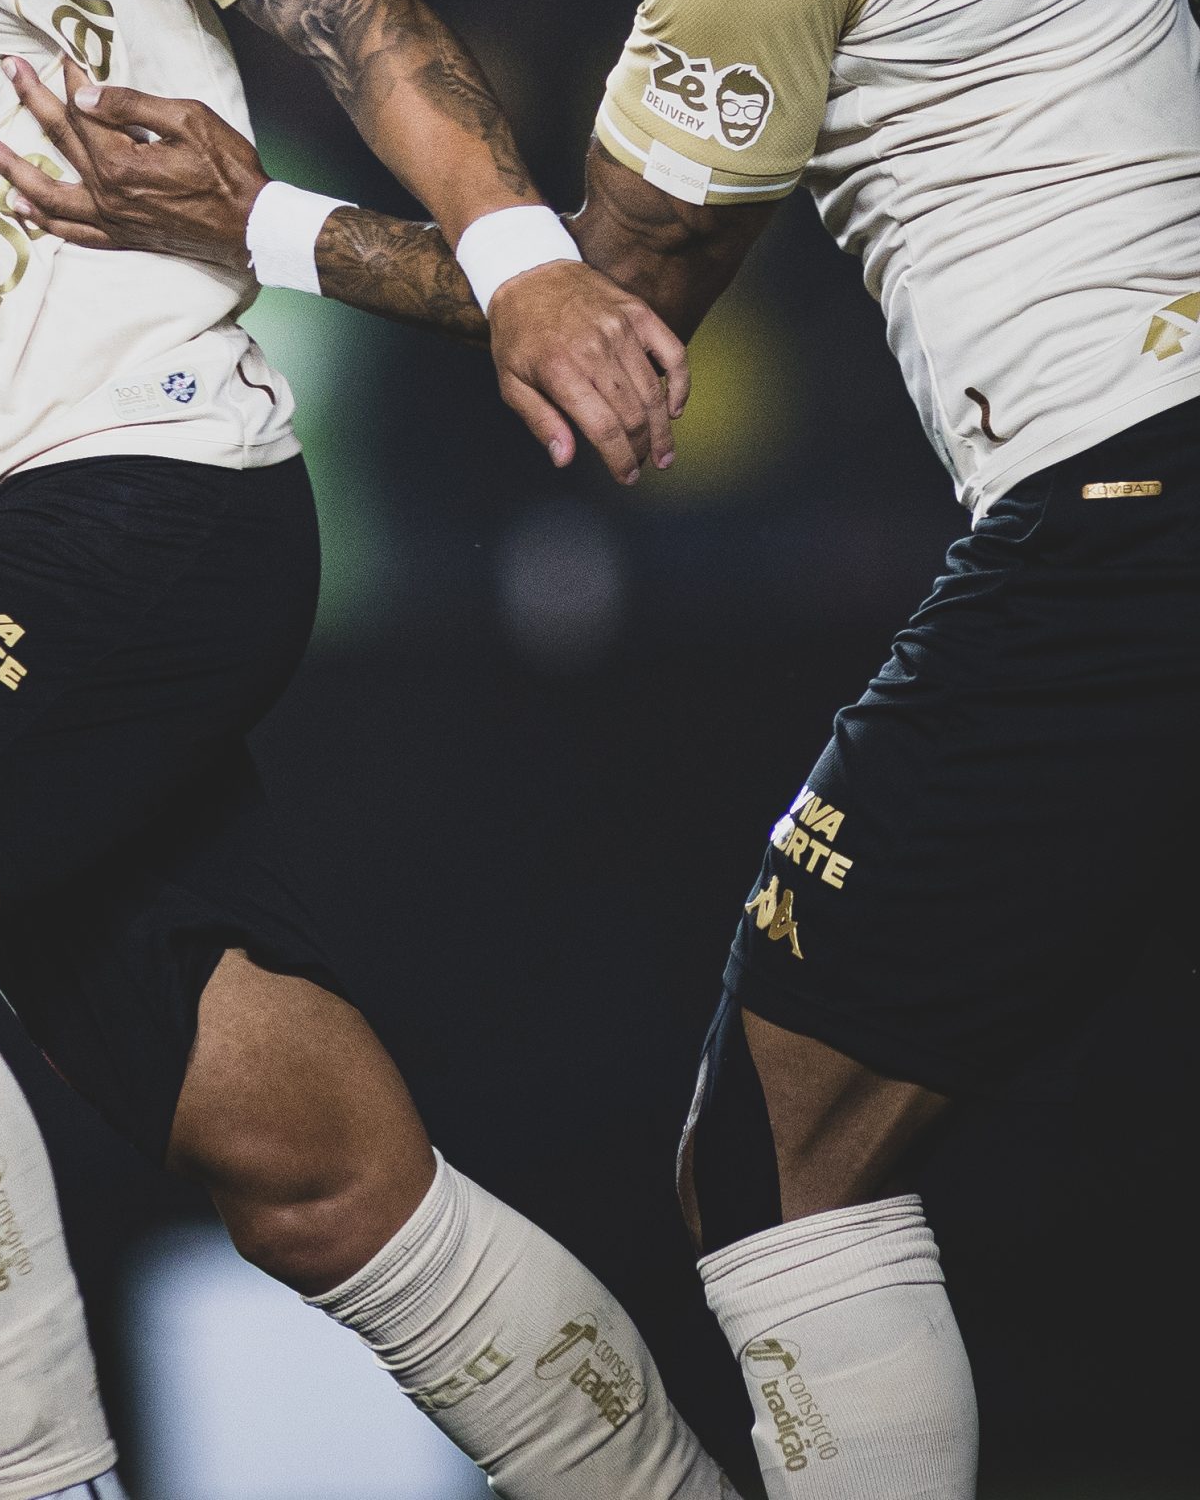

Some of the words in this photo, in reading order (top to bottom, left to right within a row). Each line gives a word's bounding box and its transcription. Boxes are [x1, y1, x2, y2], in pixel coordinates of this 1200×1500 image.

[645, 89, 705, 132] DELIVERY
[652, 42, 709, 113] Zé
[789, 784, 846, 843] VIVA
[760, 1379, 813, 1473] tradição
[785, 1373, 840, 1461] consórcio
